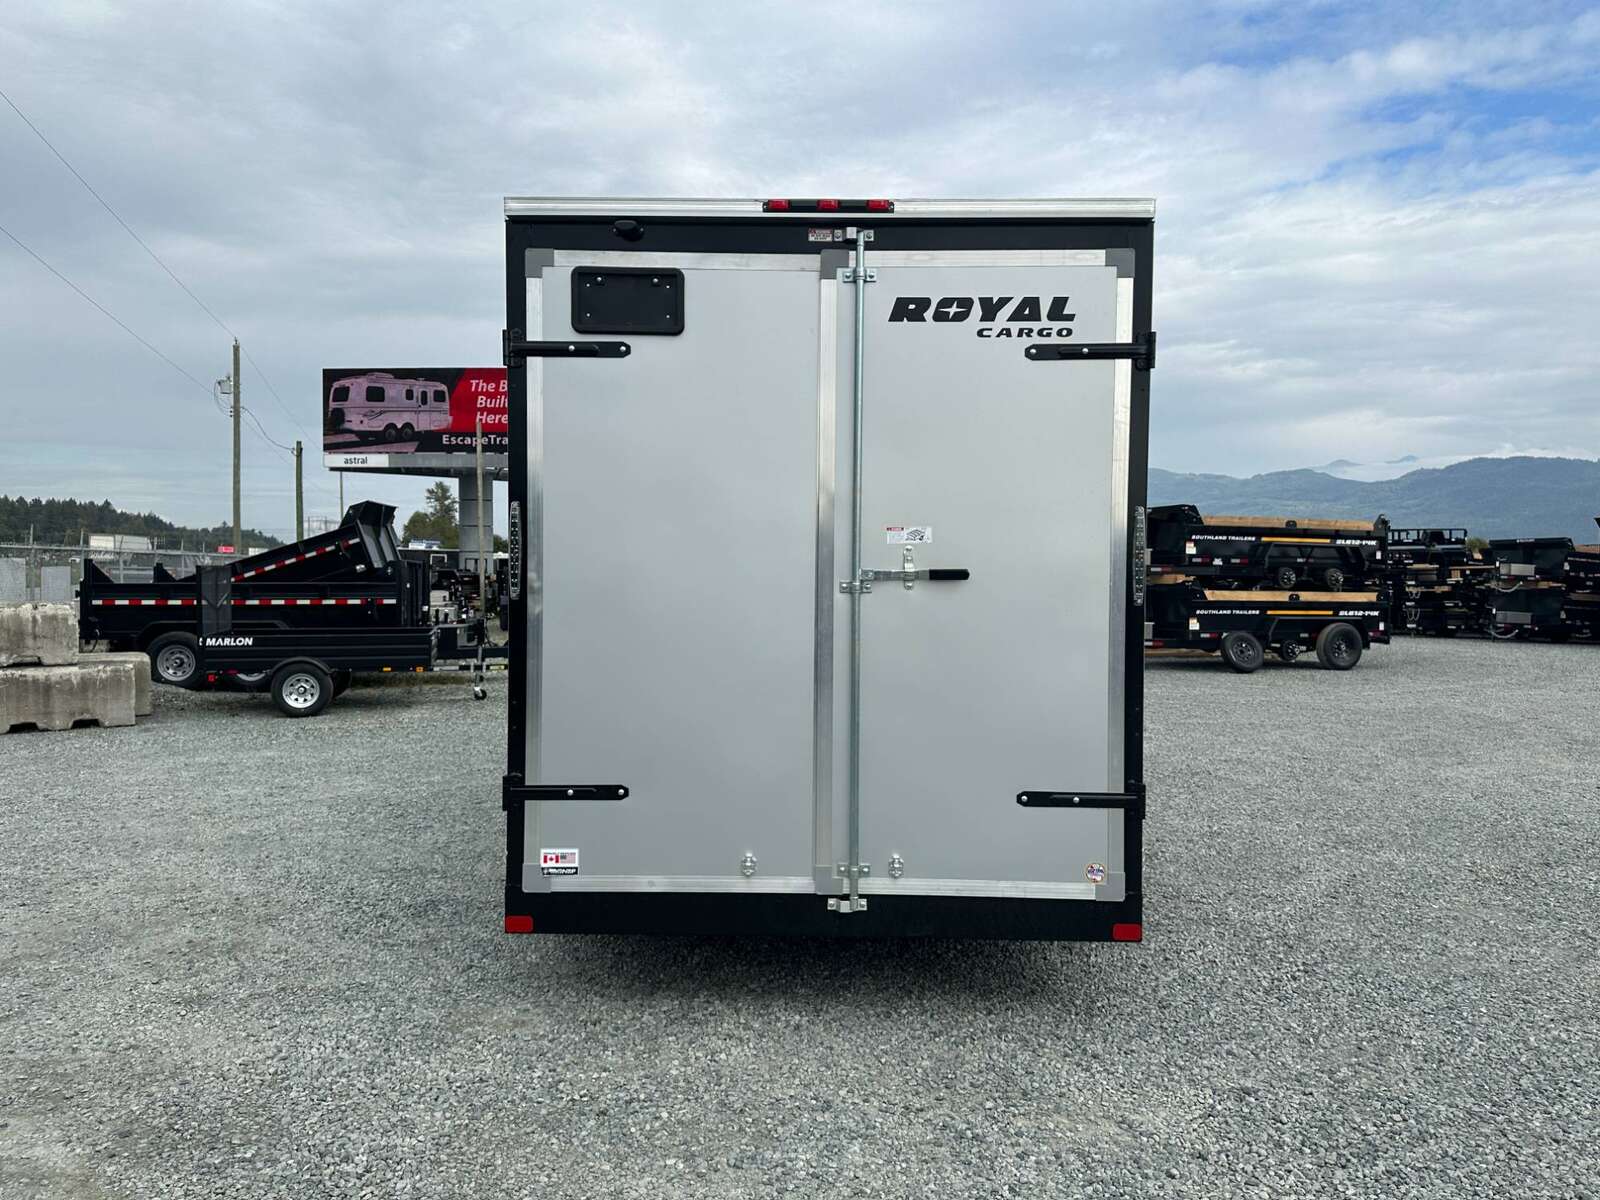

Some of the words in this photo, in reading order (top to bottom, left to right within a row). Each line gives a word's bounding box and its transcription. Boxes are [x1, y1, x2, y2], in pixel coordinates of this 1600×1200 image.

[888, 296, 1076, 322] ROYAL
[976, 327, 1074, 338] CARGO
[470, 379, 496, 393] The
[475, 411, 508, 424] Here
[343, 456, 368, 465] astral
[205, 637, 254, 646] MARLON
